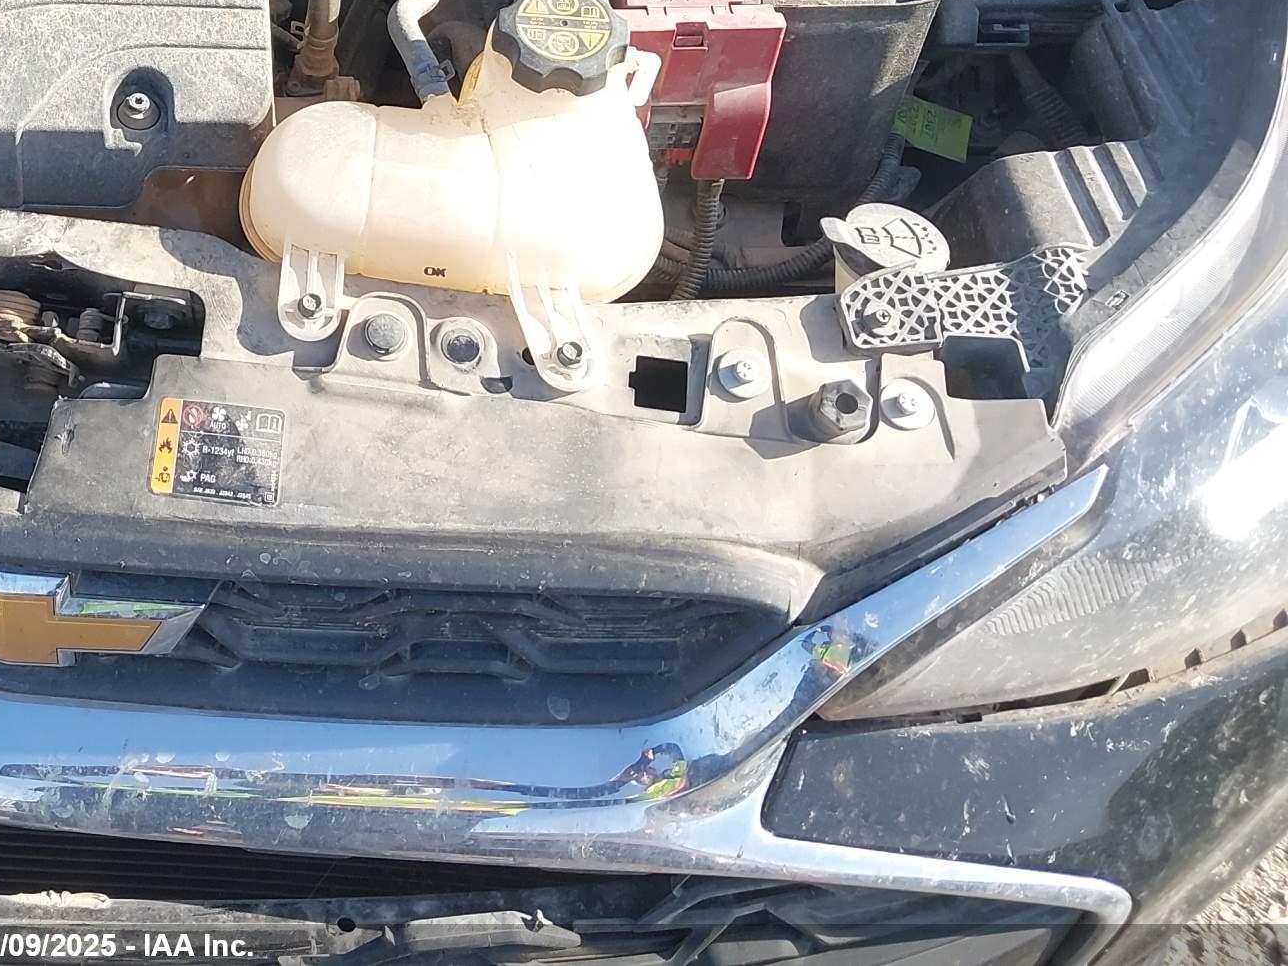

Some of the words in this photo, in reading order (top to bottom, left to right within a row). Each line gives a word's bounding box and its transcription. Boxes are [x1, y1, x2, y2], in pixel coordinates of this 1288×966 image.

[423, 266, 446, 278] OK
[209, 421, 227, 430] AUTO
[202, 445, 235, 458] R-1234yf
